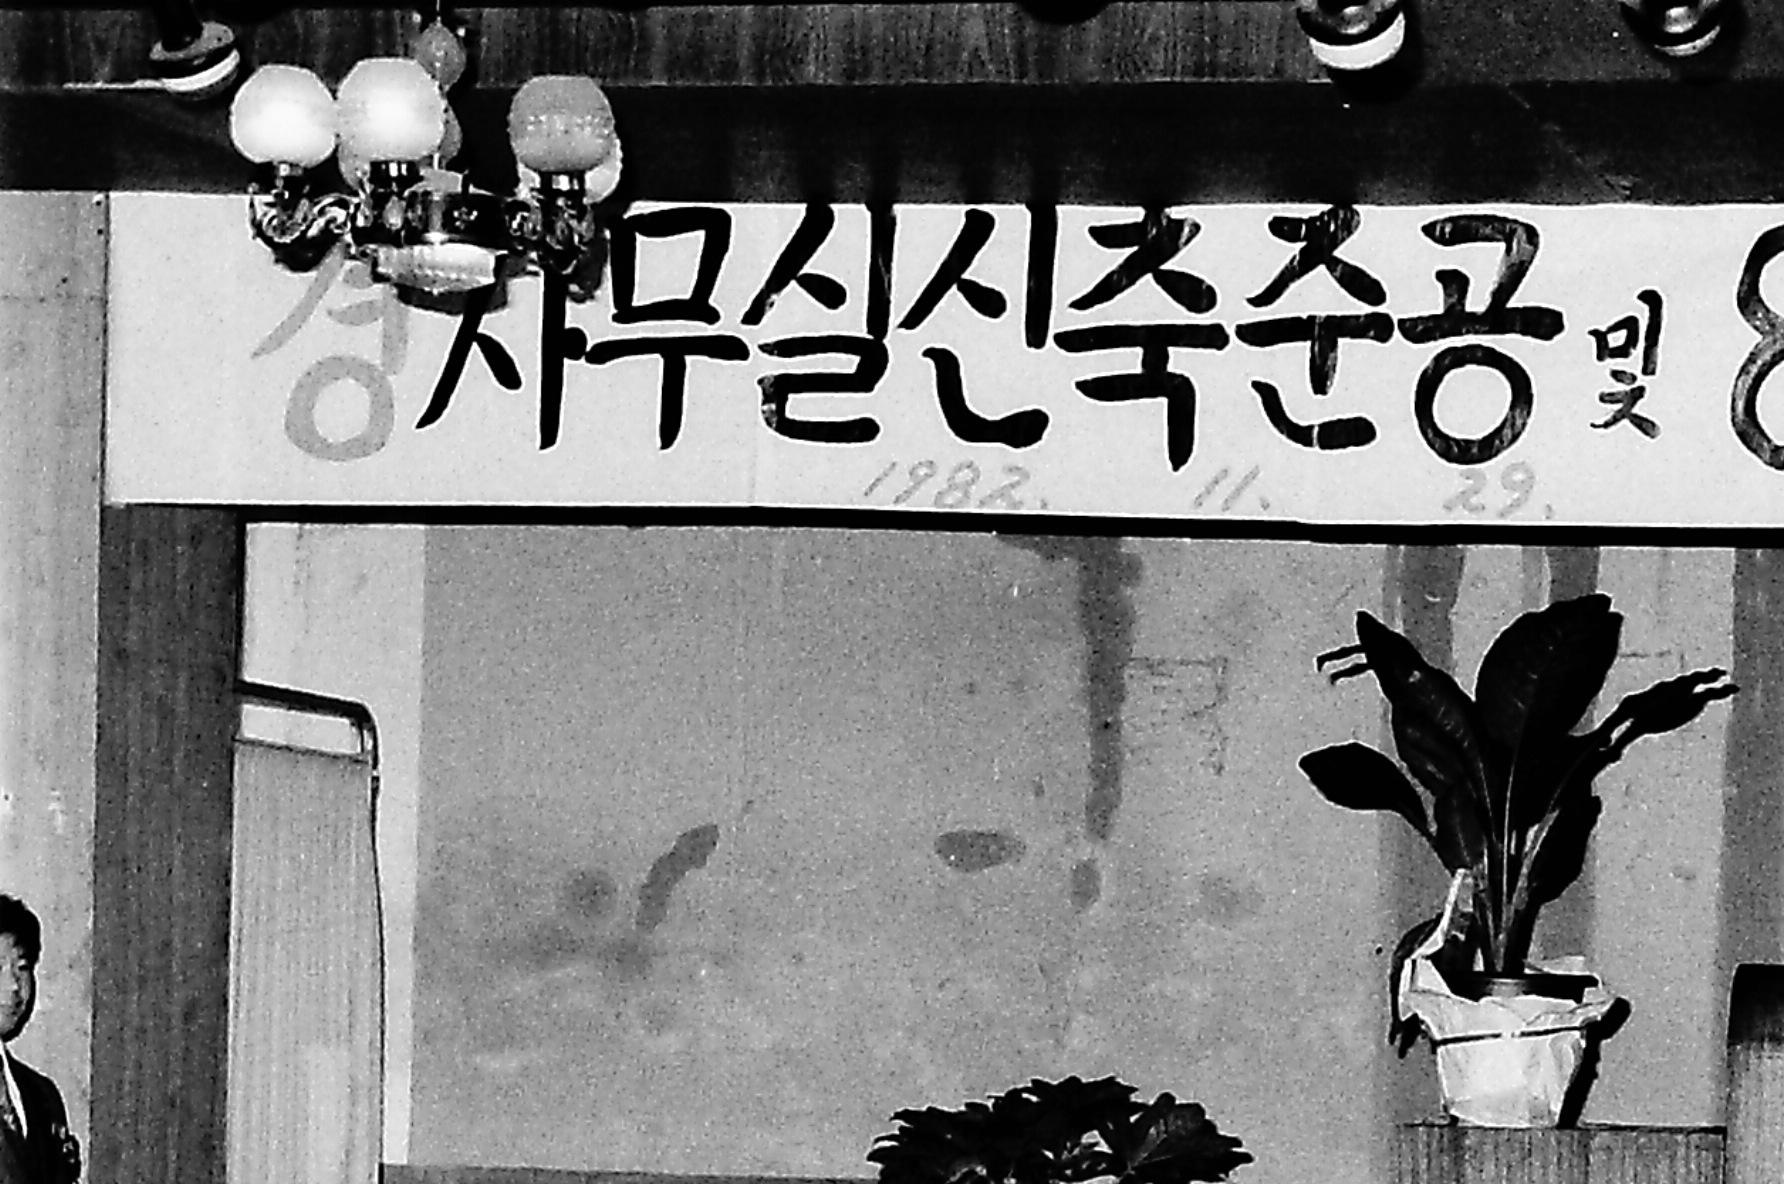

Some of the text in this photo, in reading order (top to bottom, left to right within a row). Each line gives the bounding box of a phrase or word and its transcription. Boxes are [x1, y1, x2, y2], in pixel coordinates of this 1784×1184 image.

[250, 236, 408, 462] 경
[1588, 289, 1663, 440] 및
[863, 459, 1048, 510] 1982.
[1443, 461, 1553, 520] 29.
